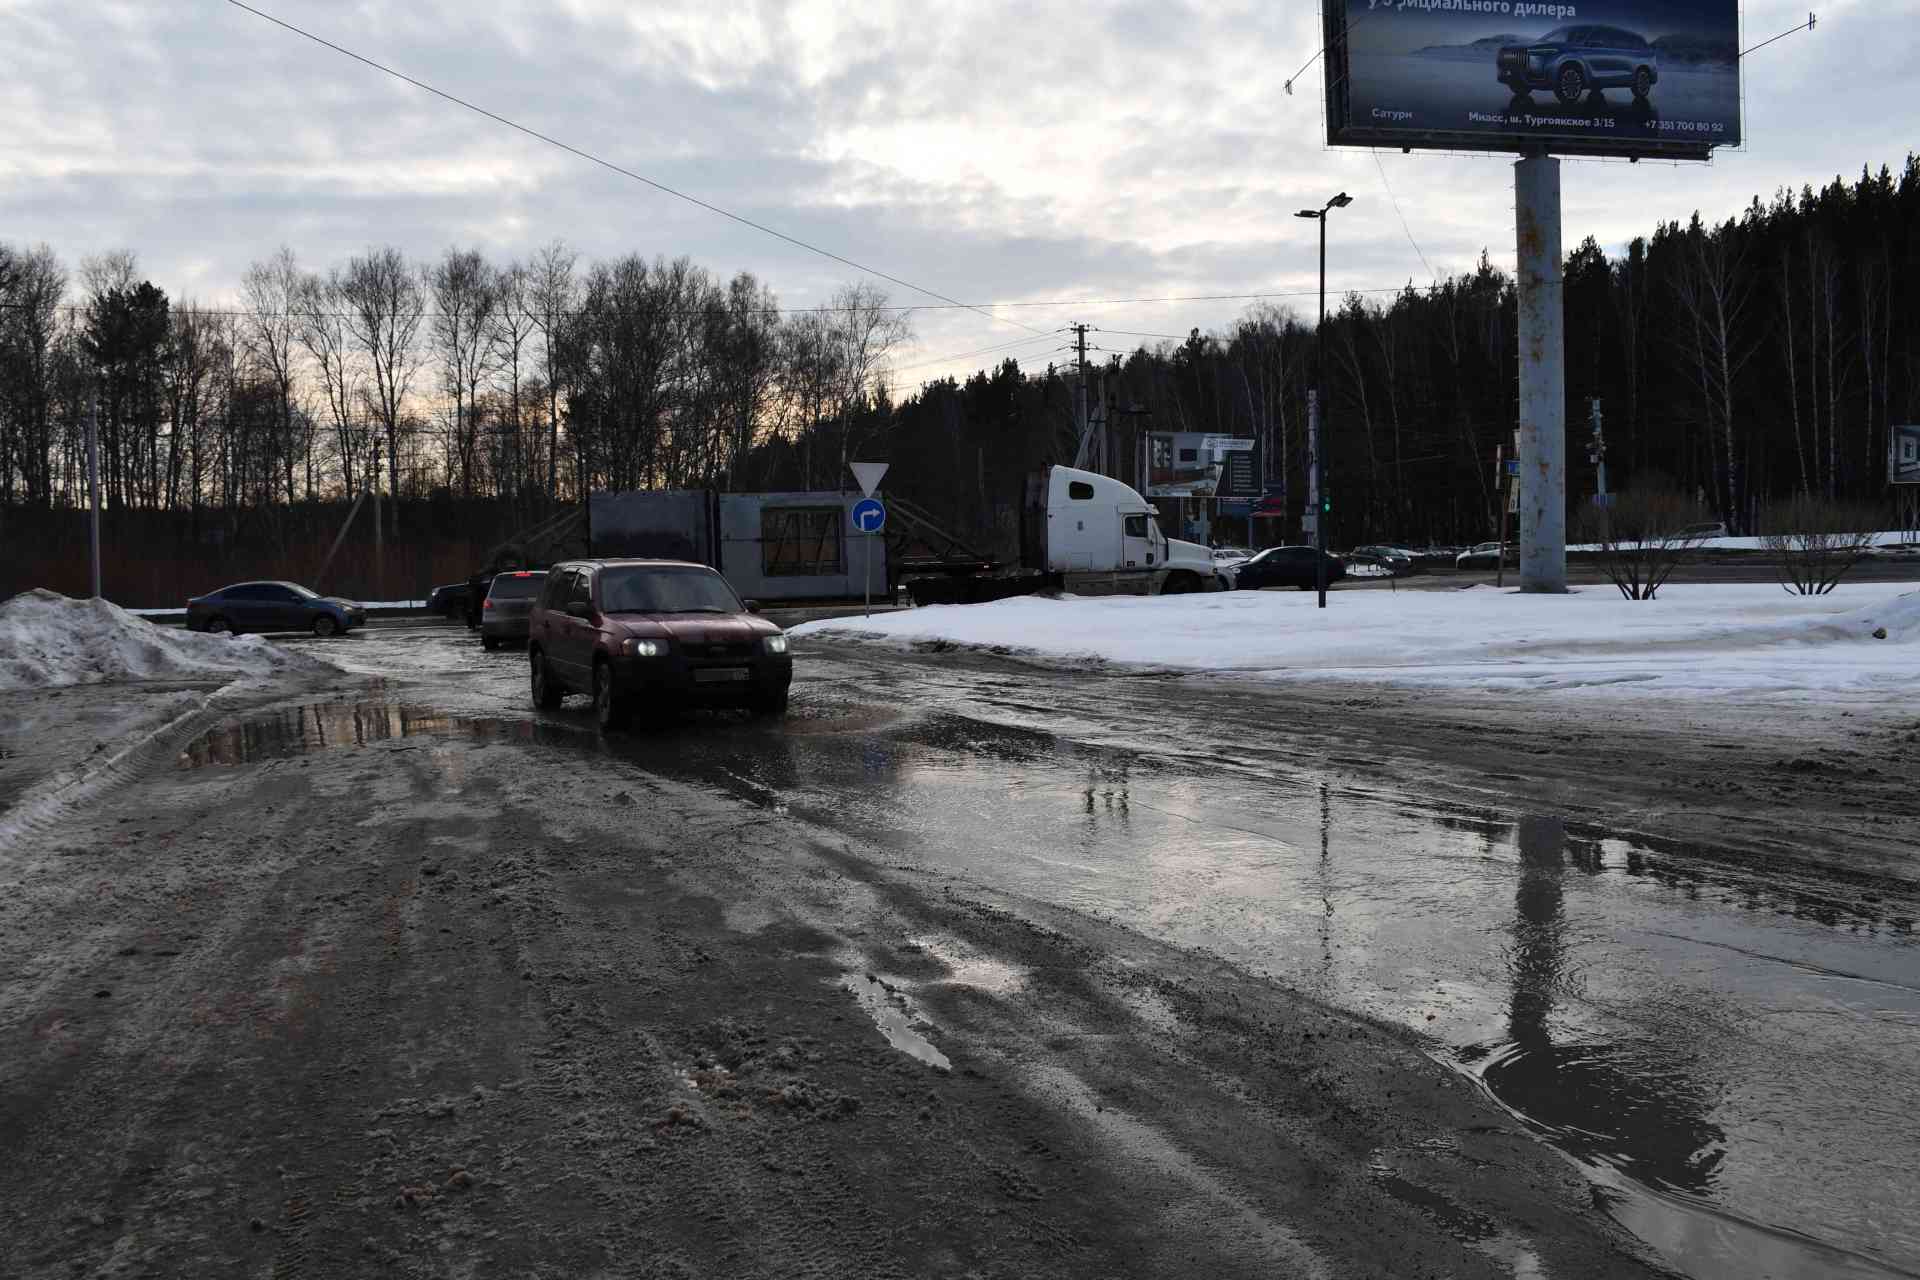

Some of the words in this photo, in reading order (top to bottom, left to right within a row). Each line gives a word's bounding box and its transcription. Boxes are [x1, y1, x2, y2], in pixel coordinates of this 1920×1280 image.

[1514, 2, 1576, 18] дилера
[1371, 107, 1413, 120] Сатурн
[1468, 111, 1507, 124] Миасс,
[1524, 114, 1591, 126] Тургоякское
[1593, 118, 1615, 128] 3/15
[1645, 119, 1657, 129] +7
[1658, 120, 1674, 130] 351
[1675, 121, 1694, 131] 700
